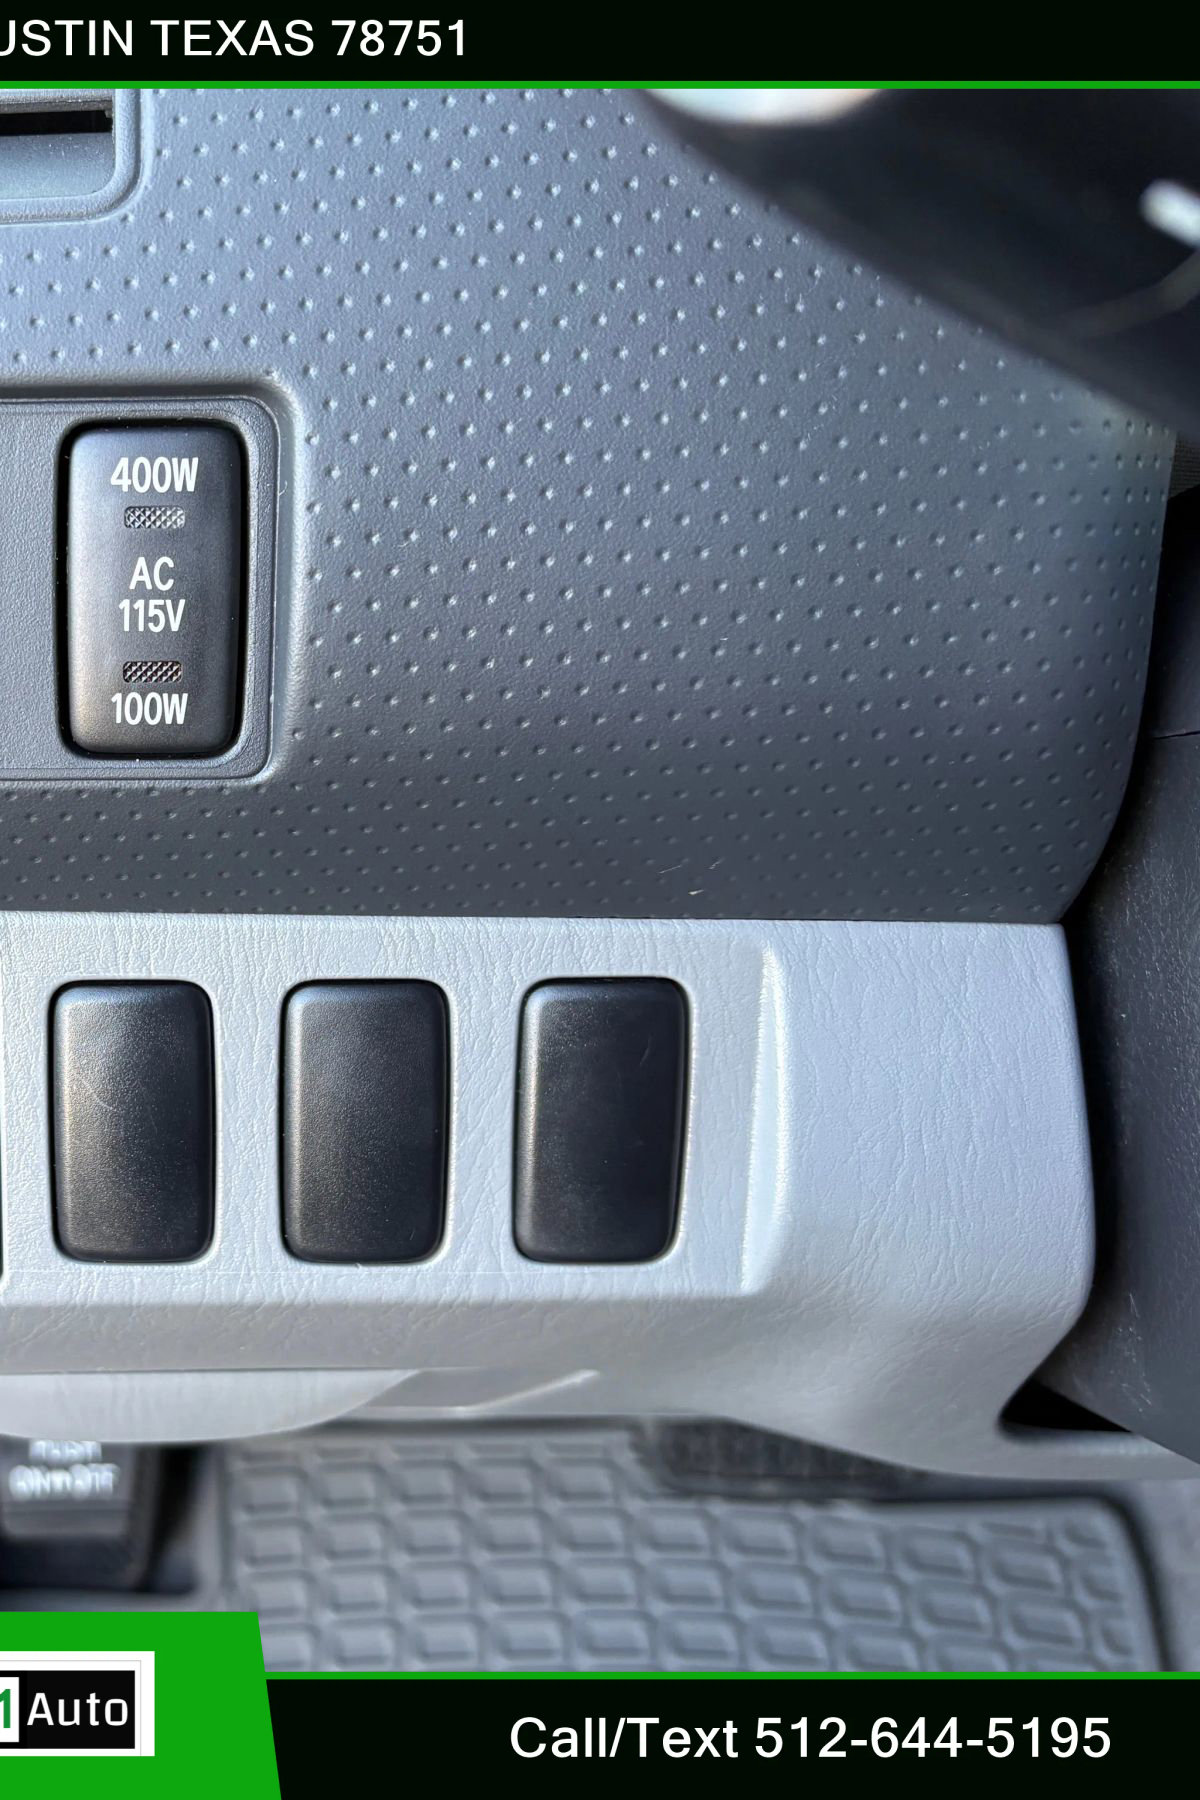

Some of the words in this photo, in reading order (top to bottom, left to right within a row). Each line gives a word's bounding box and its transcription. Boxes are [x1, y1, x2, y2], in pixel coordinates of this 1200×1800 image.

[110, 456, 199, 493] 400W
[128, 556, 175, 591] AC
[118, 598, 186, 633] 115V
[110, 692, 189, 726] 100W
